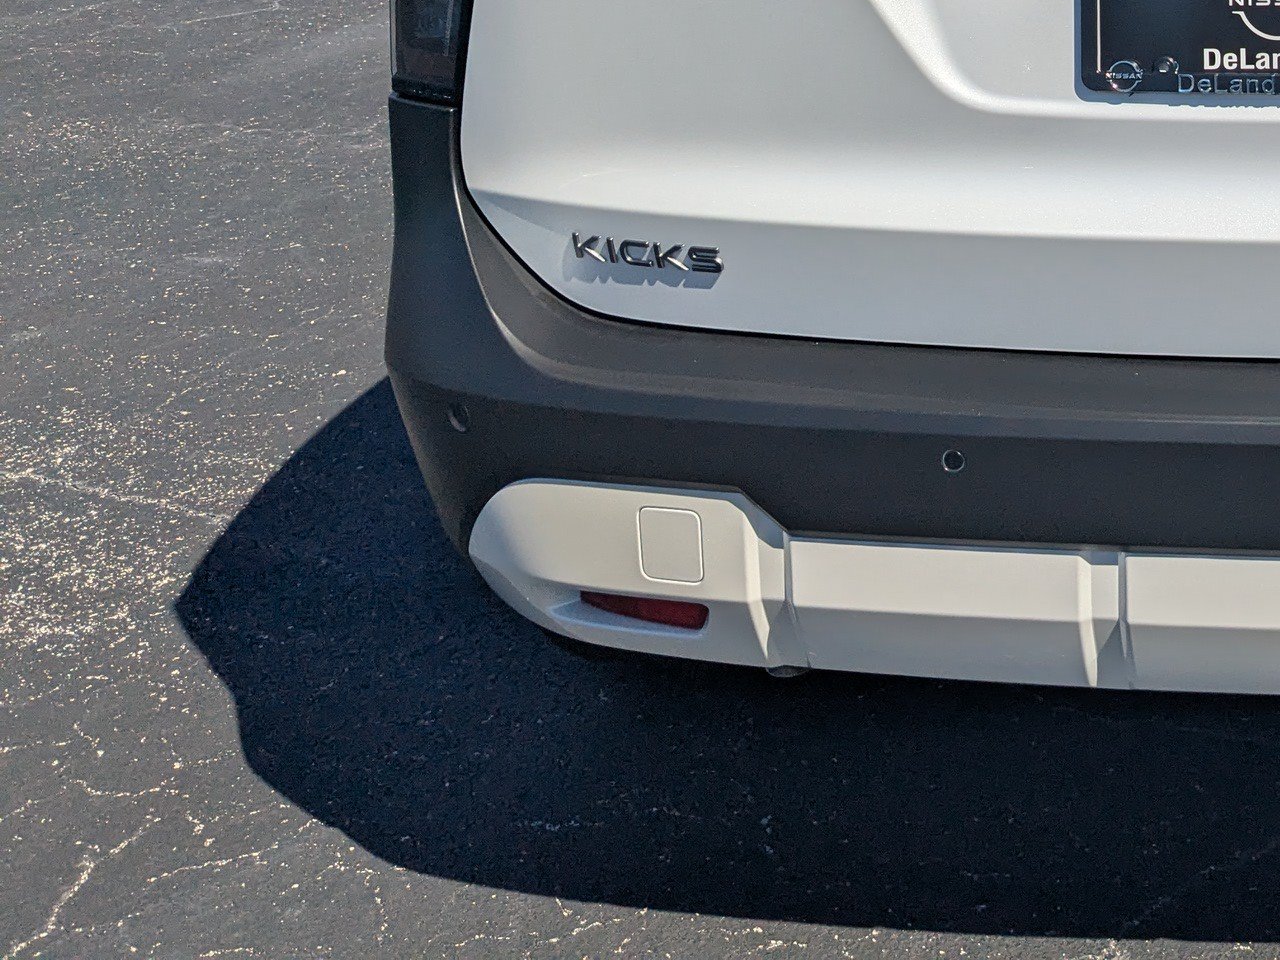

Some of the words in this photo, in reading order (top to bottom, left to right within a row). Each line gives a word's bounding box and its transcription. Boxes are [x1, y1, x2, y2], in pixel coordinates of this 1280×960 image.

[1105, 72, 1143, 80] NISSAN
[1177, 73, 1278, 94] DeLand
[571, 232, 725, 274] KICKS
